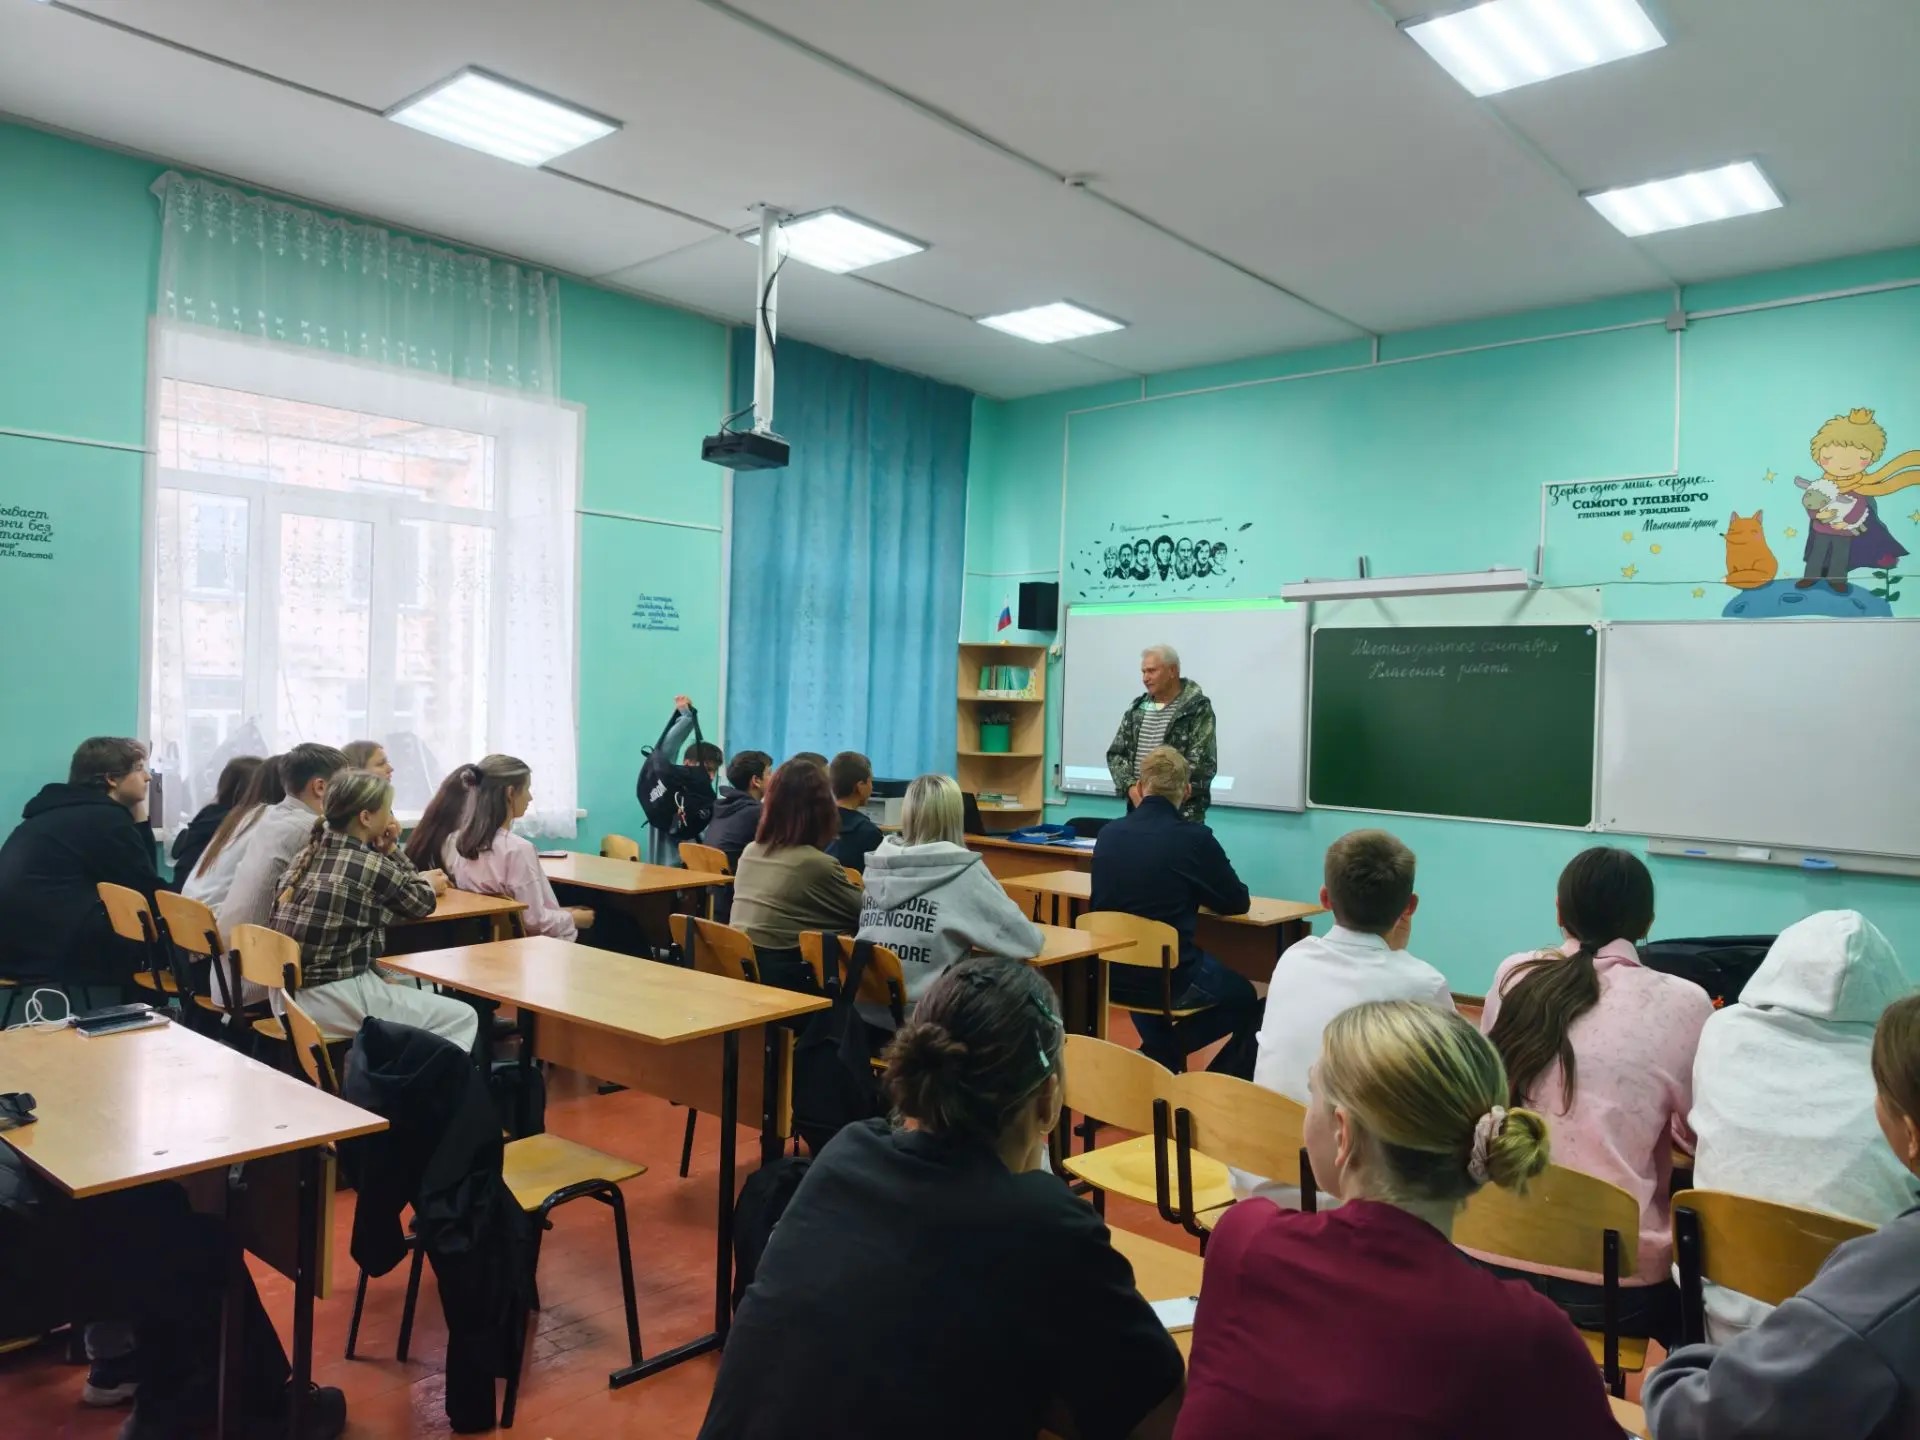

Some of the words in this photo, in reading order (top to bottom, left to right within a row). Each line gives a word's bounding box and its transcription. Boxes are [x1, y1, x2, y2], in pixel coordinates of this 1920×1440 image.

[1589, 484, 1617, 501] одно
[1621, 480, 1653, 490] лишь
[1572, 497, 1628, 510] Самого
[1633, 491, 1709, 506] главного
[0, 504, 49, 520] ывает
[1577, 510, 1621, 520] глазами
[1624, 508, 1637, 516] не
[1639, 506, 1691, 516] увидишь
[28, 519, 52, 532] без
